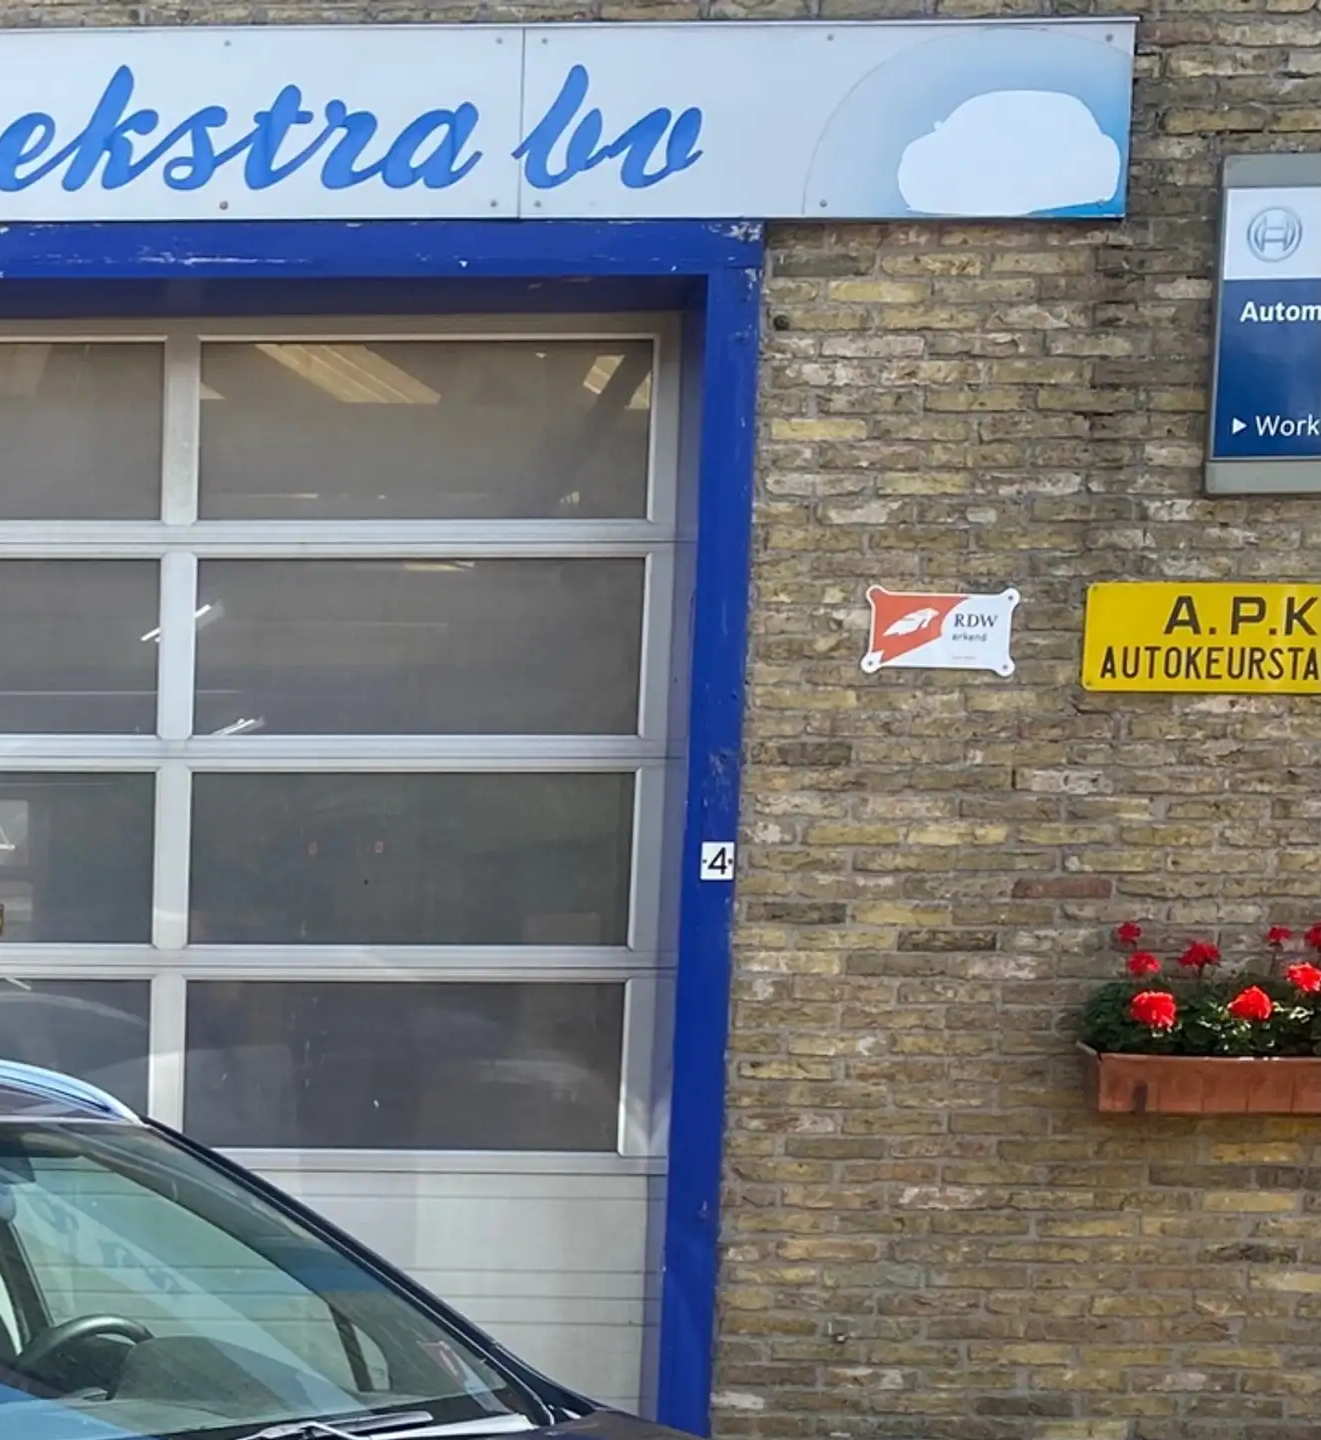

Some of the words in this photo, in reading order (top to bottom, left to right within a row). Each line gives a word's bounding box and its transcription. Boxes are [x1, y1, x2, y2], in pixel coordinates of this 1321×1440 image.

[512, 64, 704, 189] bv
[1255, 413, 1321, 437] Work
[953, 612, 999, 628] RDW
[1163, 595, 1320, 636] A.P.K
[1100, 646, 1320, 680] AUTOKEURSTA
[707, 846, 728, 875] 4
